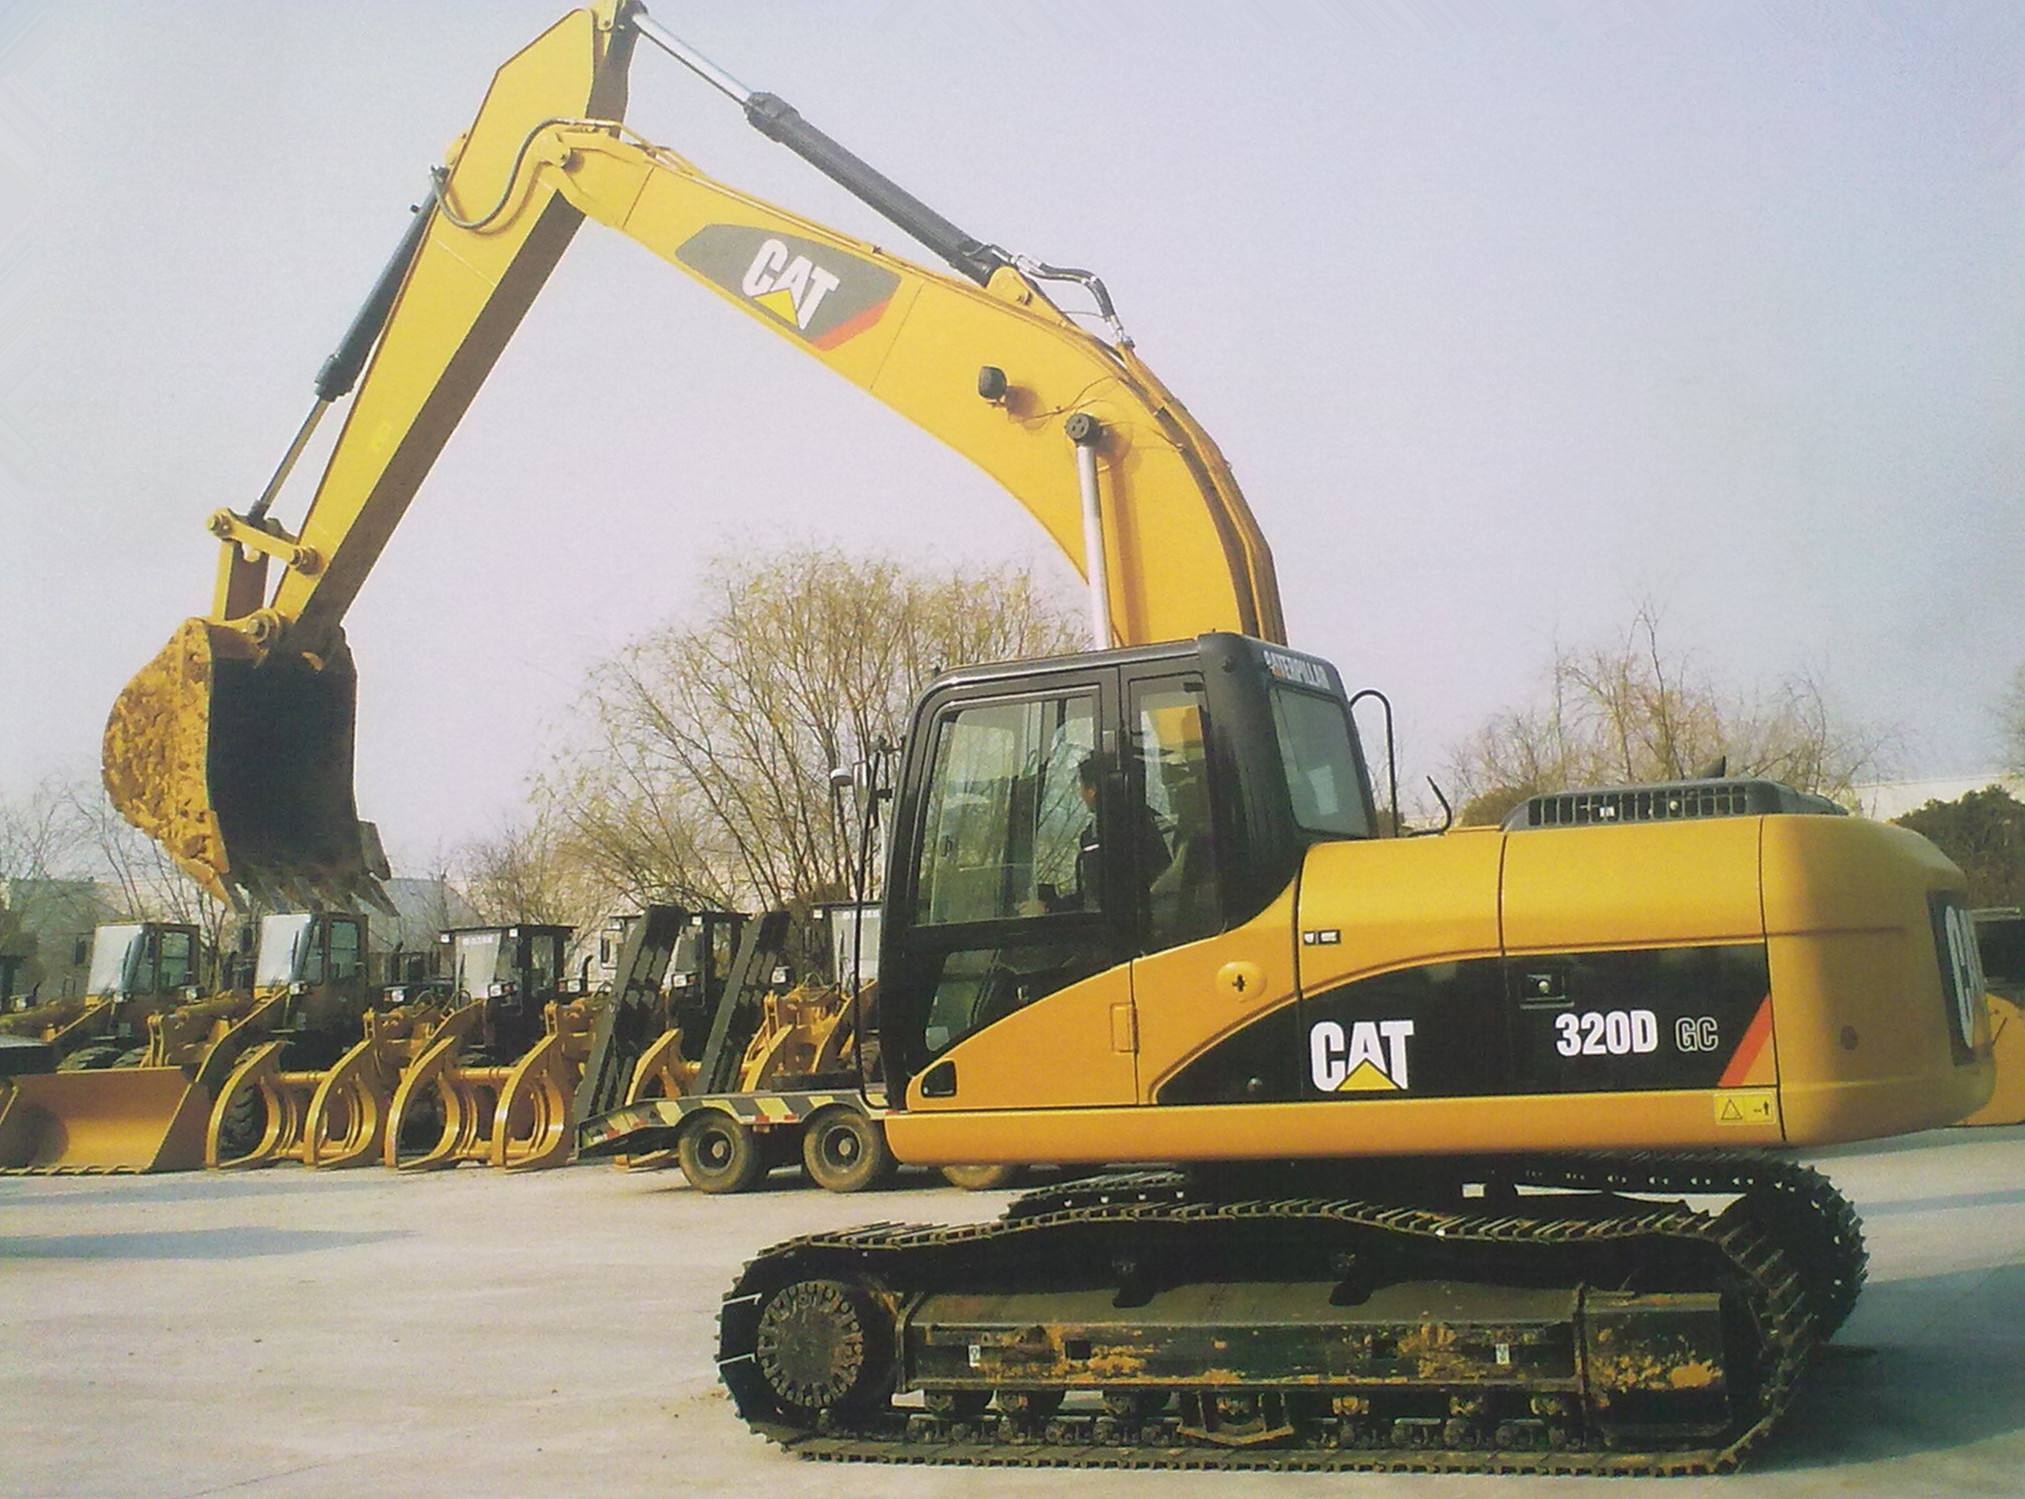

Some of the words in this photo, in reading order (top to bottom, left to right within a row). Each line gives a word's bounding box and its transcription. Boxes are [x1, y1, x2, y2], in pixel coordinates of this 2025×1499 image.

[741, 238, 840, 331] CAT
[1310, 1020, 1415, 1092] CAT
[1555, 1010, 1658, 1057] 320D
[1675, 1016, 1719, 1053] GC
